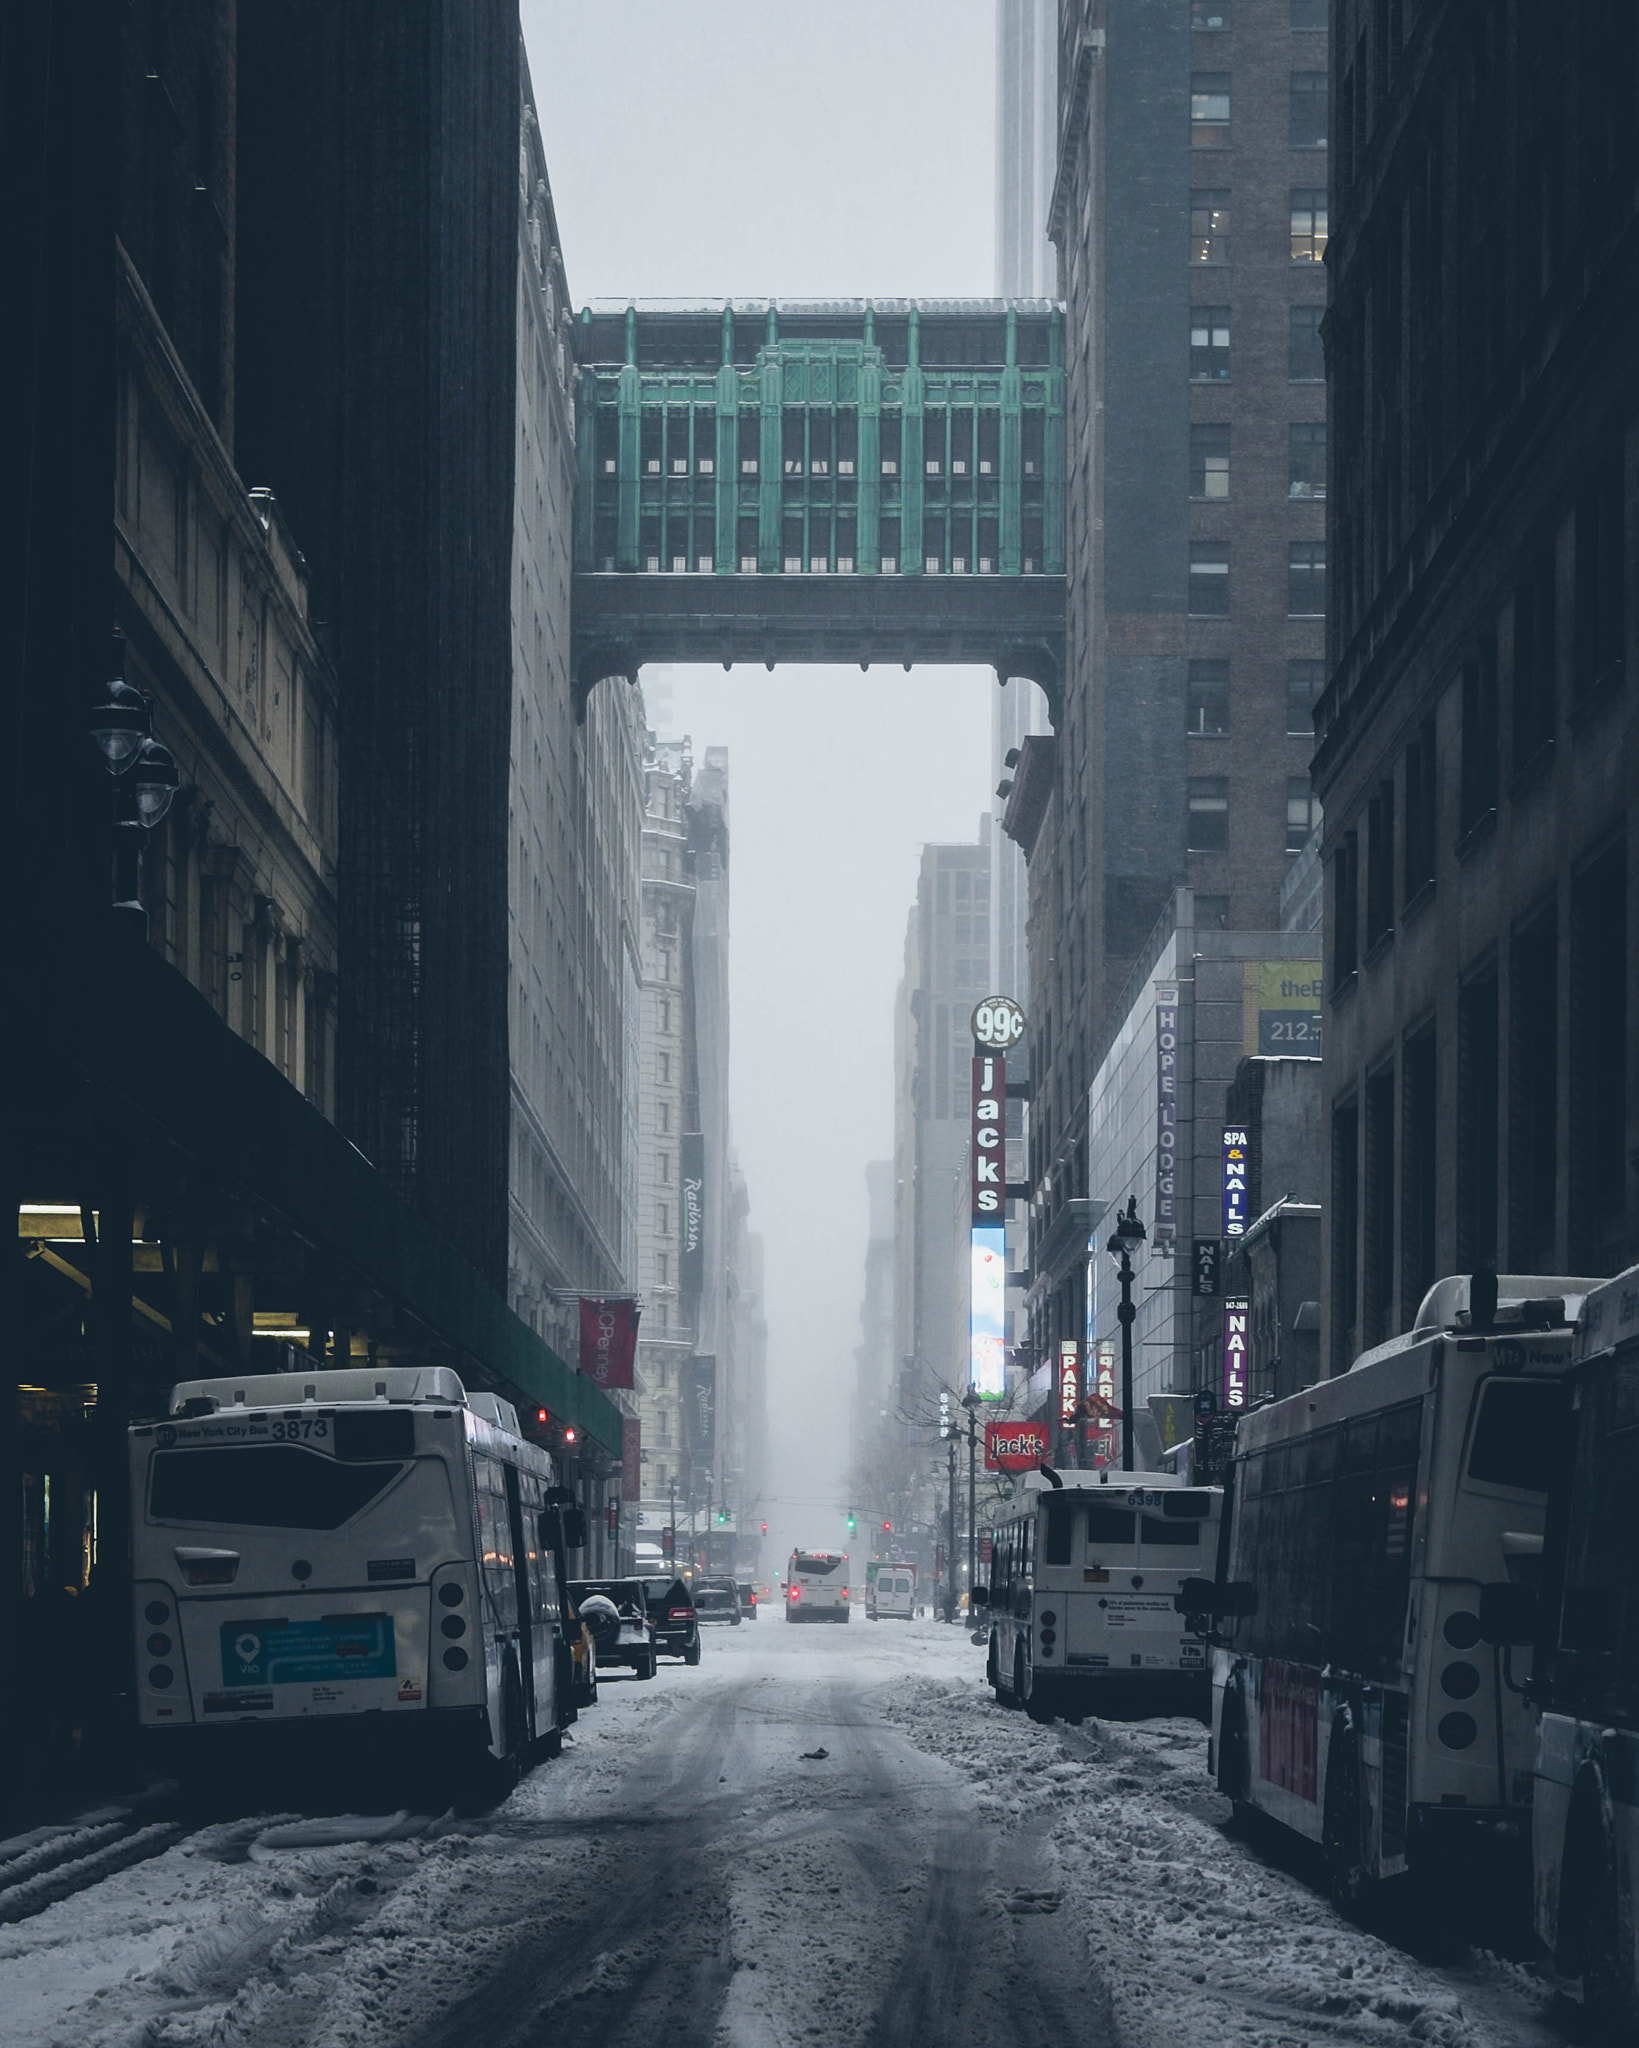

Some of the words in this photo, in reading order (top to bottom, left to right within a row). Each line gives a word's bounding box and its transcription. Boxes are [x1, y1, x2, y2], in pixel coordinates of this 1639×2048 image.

[976, 1006, 1023, 1042] 99¢
[1159, 1012, 1175, 1093] HOPE
[977, 1057, 1000, 1211] jacks
[1224, 1132, 1248, 1146] SPA
[1228, 1149, 1244, 1159] &
[1159, 1109, 1175, 1216] LODGE
[683, 1177, 702, 1253] Radisson
[1226, 1163, 1246, 1235] NAILS
[1198, 1245, 1214, 1294] NAILS
[591, 1305, 615, 1385] JCPenney
[1227, 1315, 1246, 1407] NAILS
[1529, 1350, 1563, 1365] New
[1062, 1355, 1077, 1412] PARK
[179, 1428, 200, 1438] New
[202, 1427, 225, 1438] York
[227, 1426, 246, 1437] City
[249, 1425, 268, 1435] Bus
[271, 1419, 328, 1440] 3873
[990, 1434, 1044, 1460] Jack's
[240, 1664, 261, 1674] via
